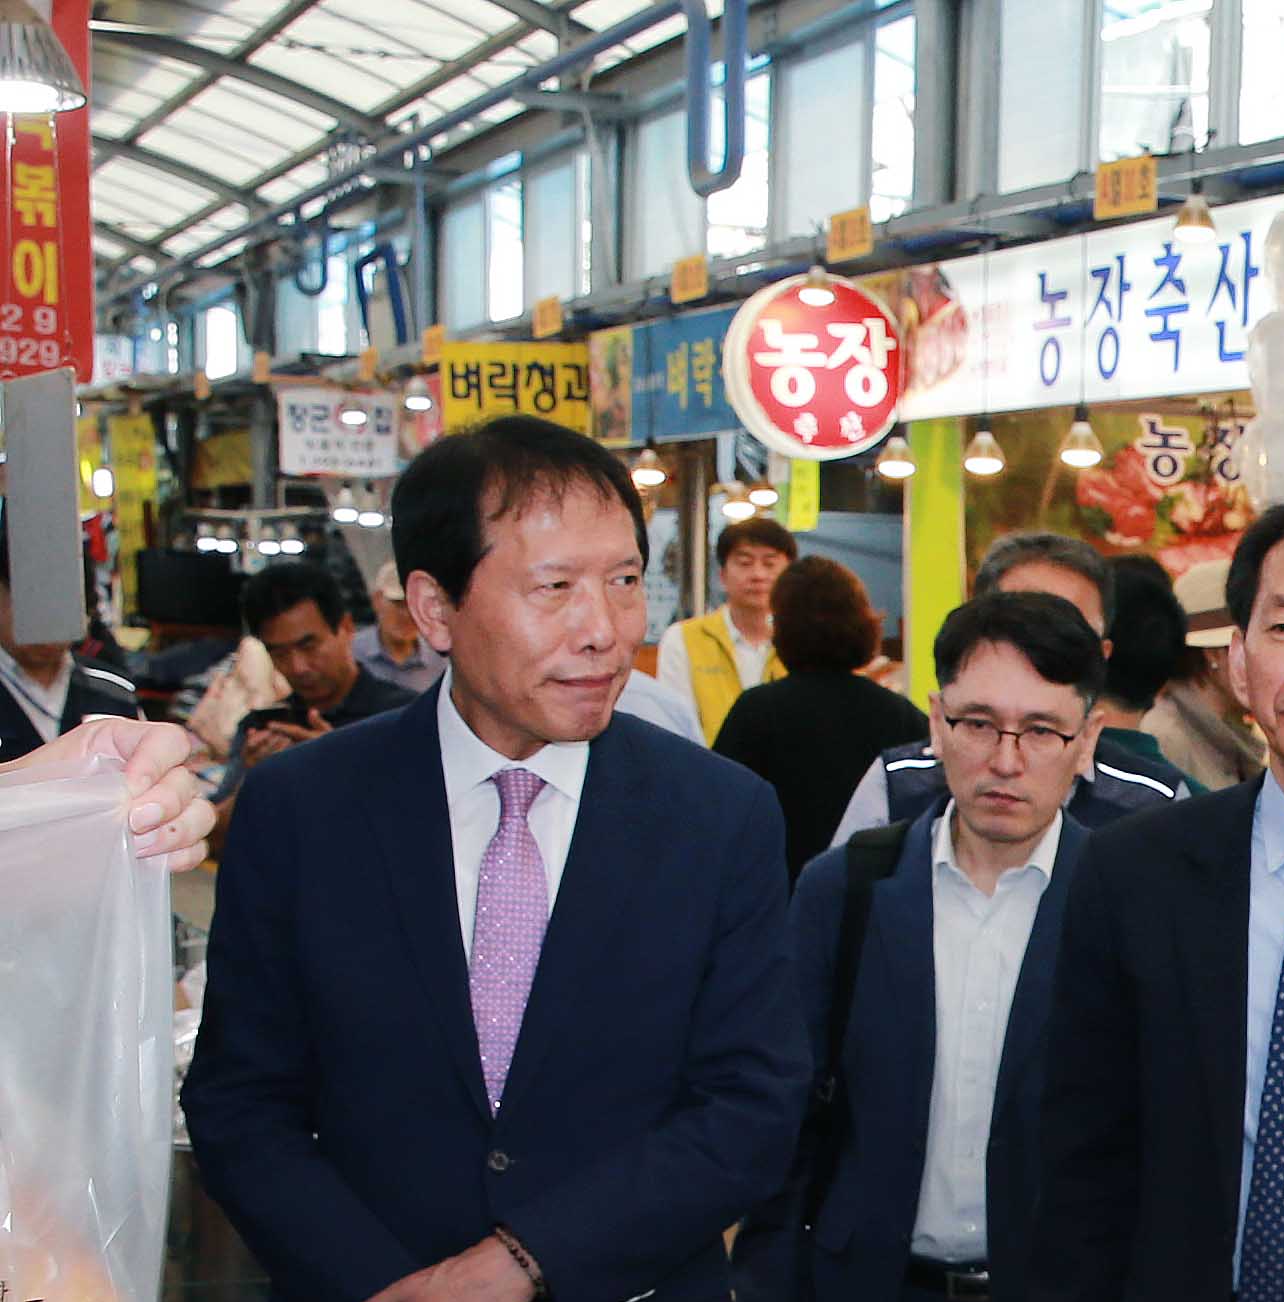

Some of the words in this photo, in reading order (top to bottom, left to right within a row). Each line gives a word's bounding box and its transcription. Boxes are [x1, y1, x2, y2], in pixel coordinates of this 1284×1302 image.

[1033, 231, 1259, 386] 농장축산
[451, 361, 590, 412] 벼락청과
[754, 318, 896, 407] 농장
